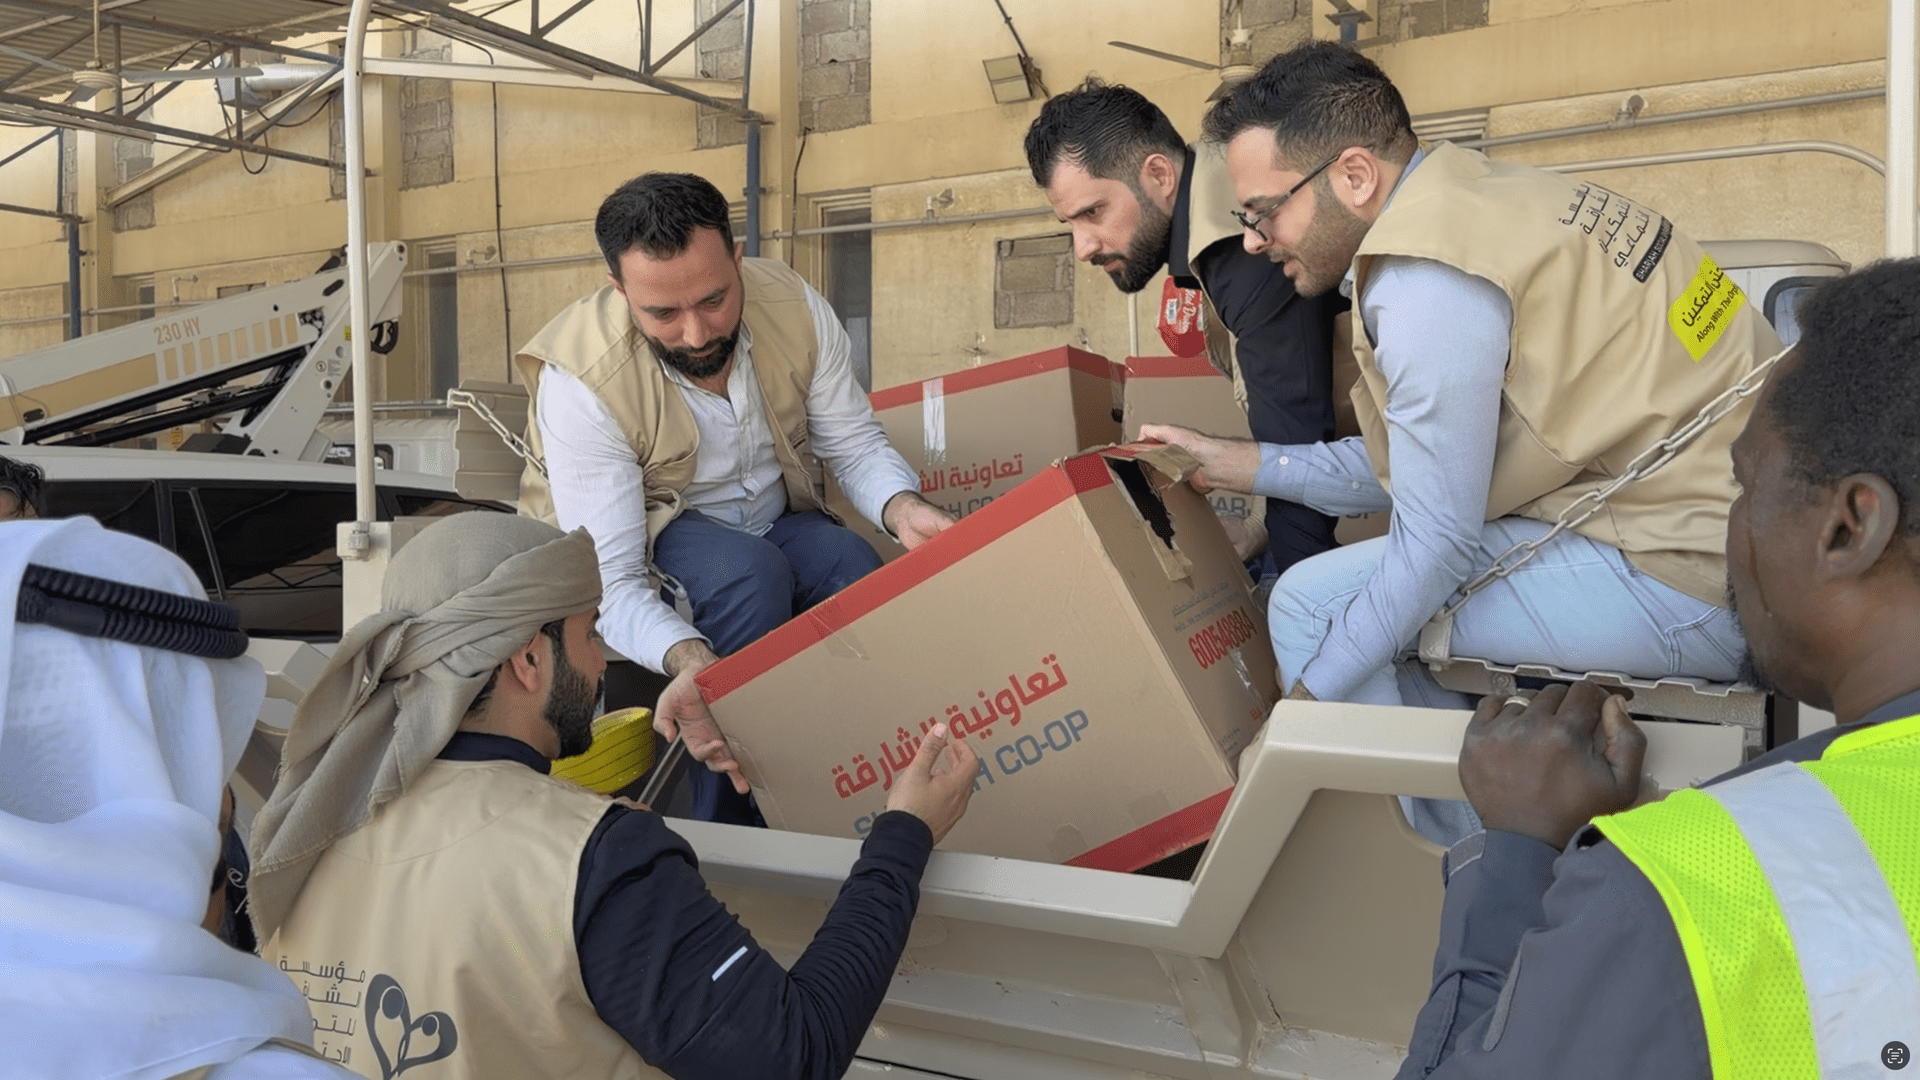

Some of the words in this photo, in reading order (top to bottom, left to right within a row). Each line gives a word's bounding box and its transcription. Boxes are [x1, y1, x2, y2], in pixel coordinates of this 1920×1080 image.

[153, 322, 182, 345] 230
[182, 316, 201, 337] HY
[1696, 321, 1716, 343] Along
[948, 453, 1024, 491] تعاونية
[944, 653, 1068, 741] تعاونية
[994, 709, 1089, 776] CO-OP
[280, 955, 366, 984] مؤسسة
